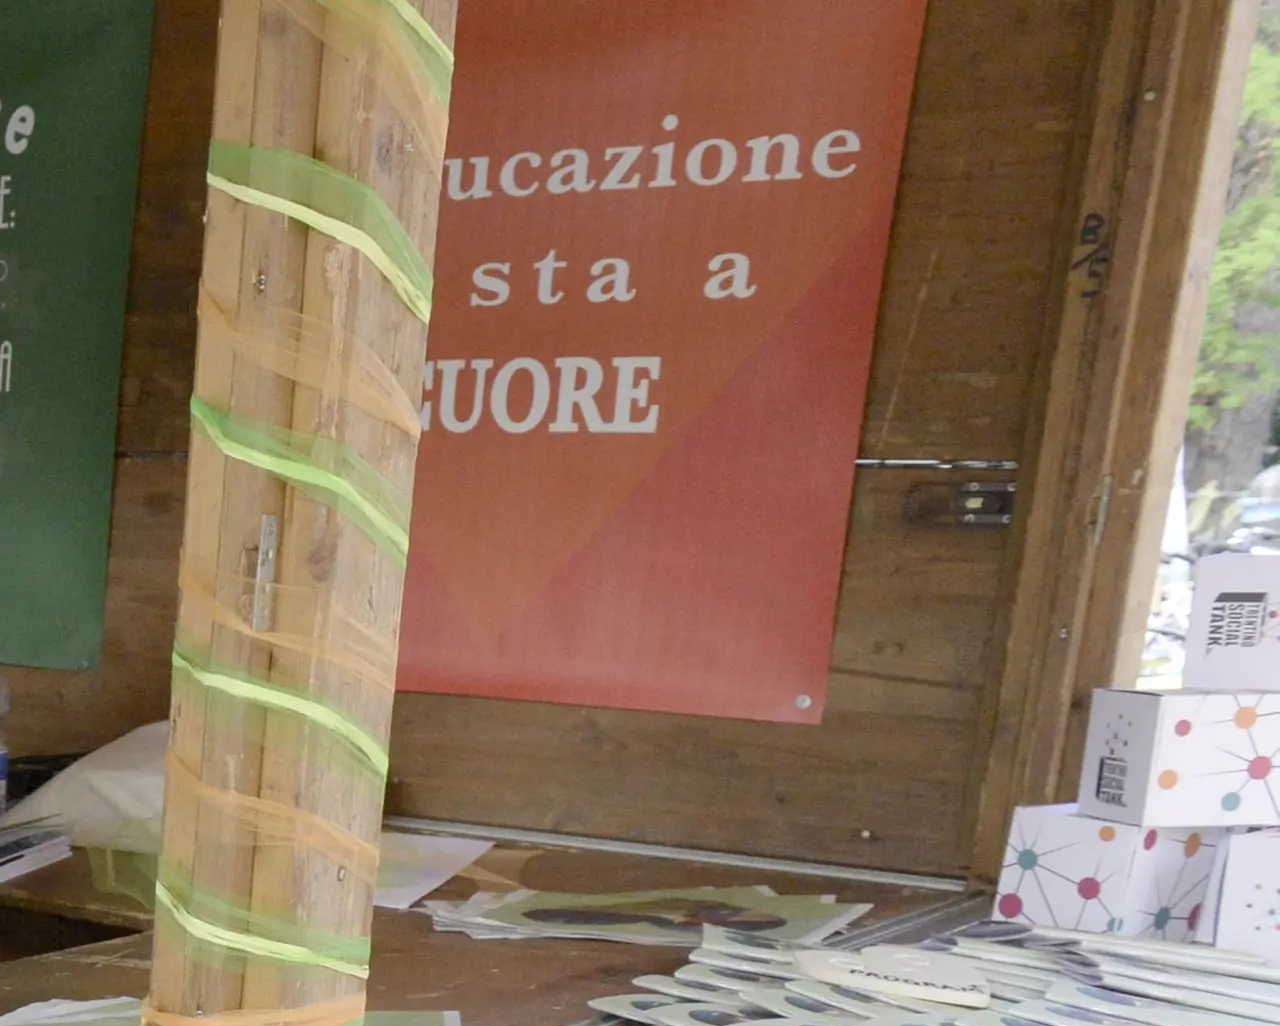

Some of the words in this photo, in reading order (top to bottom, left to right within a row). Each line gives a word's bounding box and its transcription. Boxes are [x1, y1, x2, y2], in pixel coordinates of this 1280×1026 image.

[443, 113, 862, 201] ucazione
[704, 250, 757, 300] a
[1207, 603, 1226, 648] TANK
[1225, 603, 1244, 648] SOCIAL
